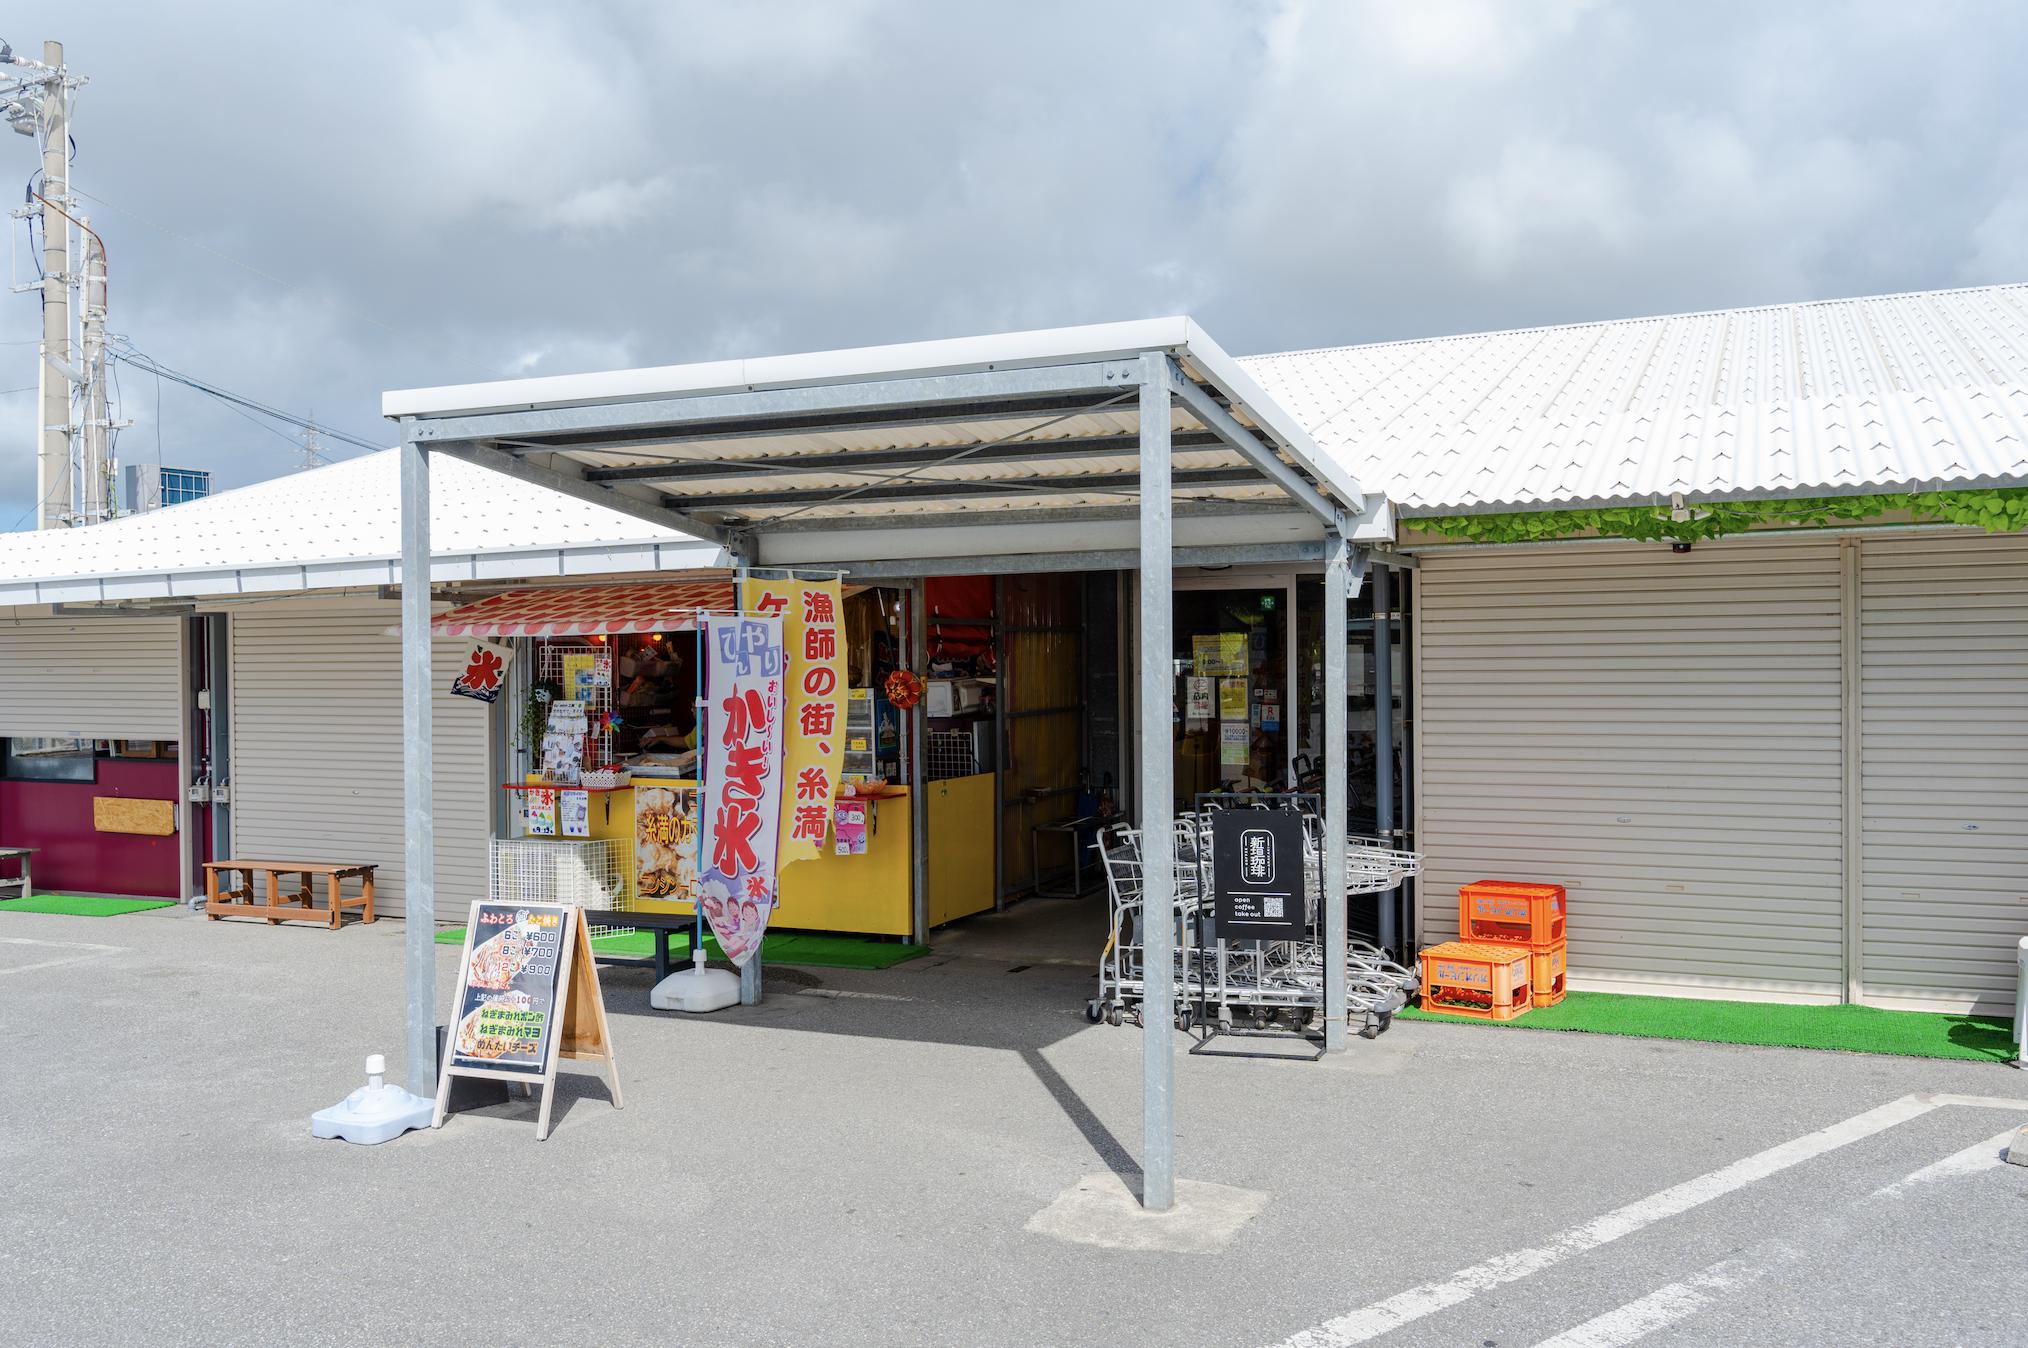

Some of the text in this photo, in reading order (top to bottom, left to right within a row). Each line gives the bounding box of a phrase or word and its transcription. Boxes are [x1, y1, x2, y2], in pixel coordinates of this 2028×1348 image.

[461, 650, 503, 690] 氷
[792, 591, 836, 839] 漁師の街、糸満
[713, 682, 768, 877] かき氷
[1250, 836, 1267, 878] 新垣珈琲
[746, 876, 769, 899] 氷
[480, 912, 513, 924] ふわとろ
[526, 931, 555, 942] ¥600
[524, 947, 553, 958] ¥700
[520, 964, 551, 975] ¥900
[480, 1024, 541, 1039] ねぎまみれマヨ
[477, 1040, 539, 1053] めんたいチーズ
